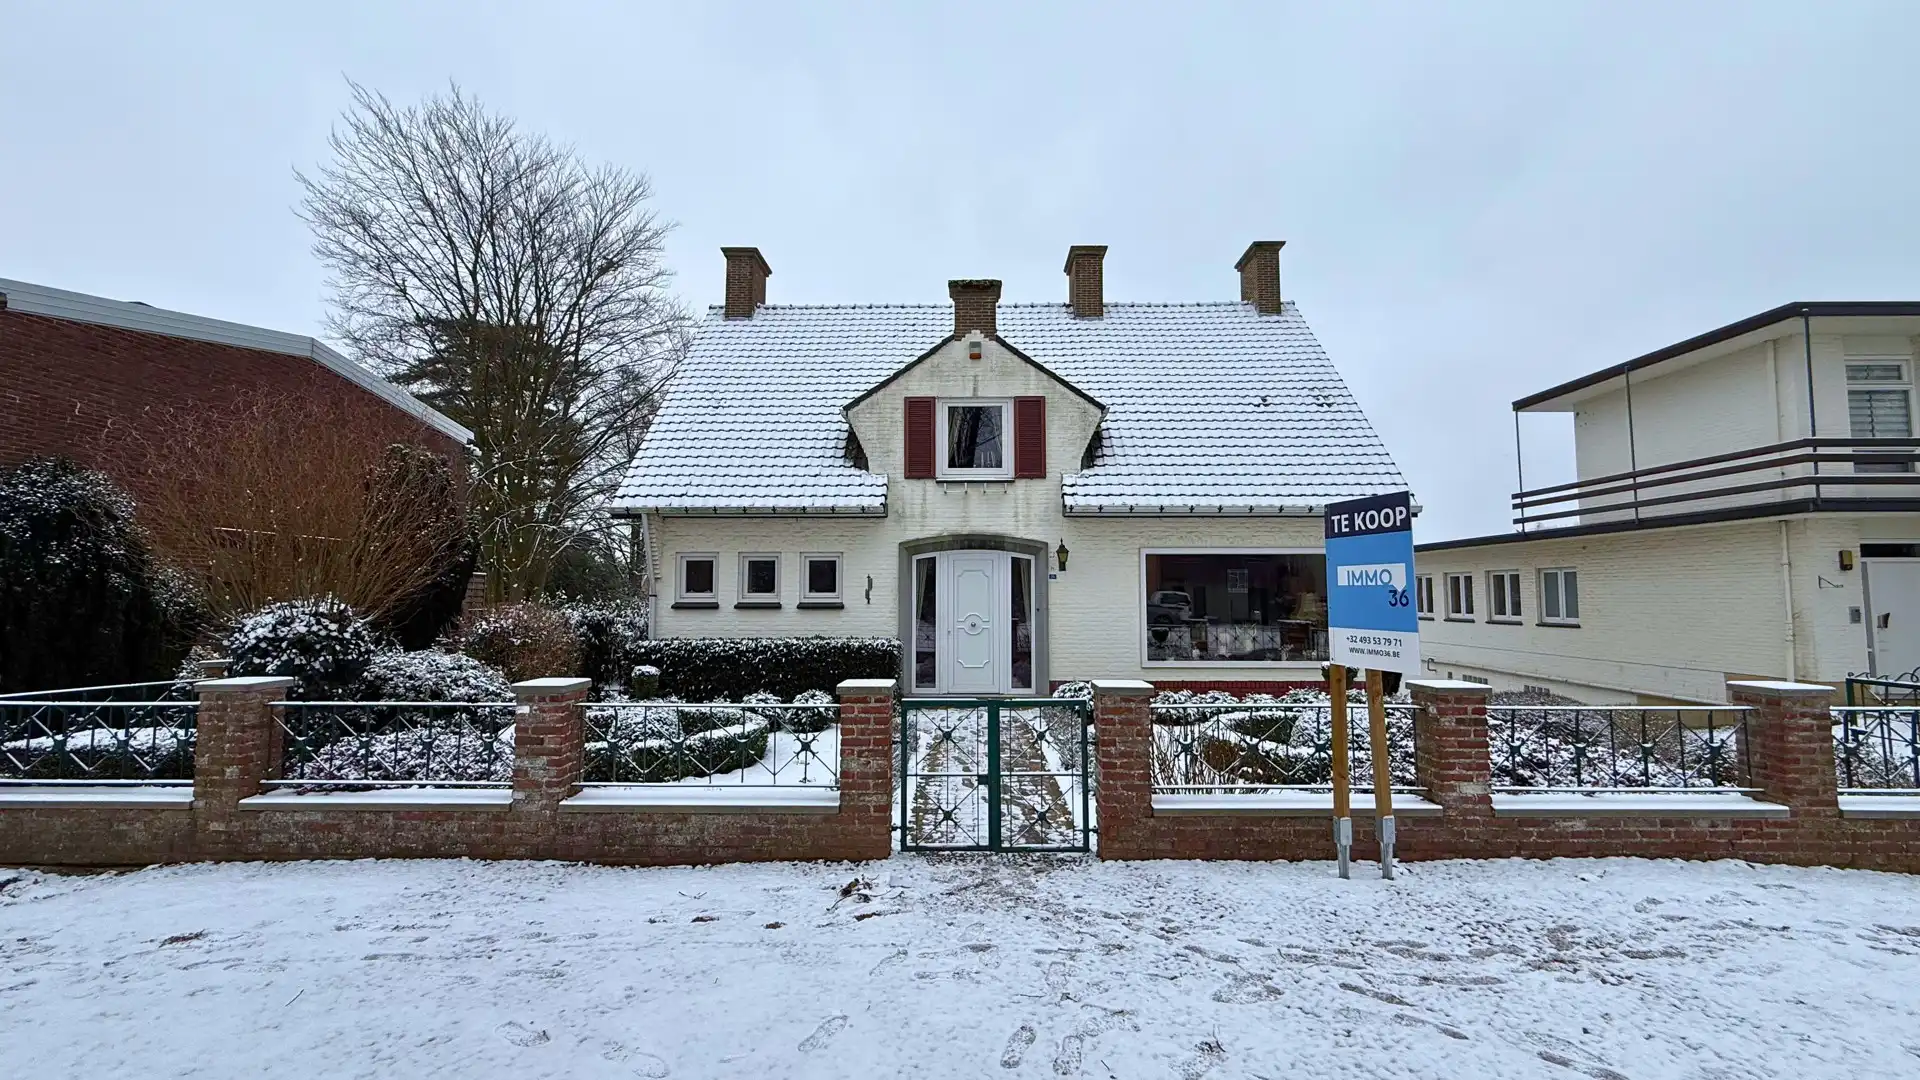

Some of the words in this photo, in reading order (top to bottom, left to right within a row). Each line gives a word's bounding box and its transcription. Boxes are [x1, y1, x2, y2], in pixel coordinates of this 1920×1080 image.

[1331, 514, 1350, 533] TE
[1354, 506, 1407, 531] KOOP
[1347, 569, 1392, 586] IMMO
[1388, 589, 1410, 607] 36
[1346, 635, 1358, 644] +32
[1359, 636, 1371, 645] 493
[1372, 636, 1382, 645] 53
[1382, 637, 1392, 646] 79
[1393, 638, 1402, 647] 71
[1349, 647, 1401, 658] WWW.IMMO36.BE
